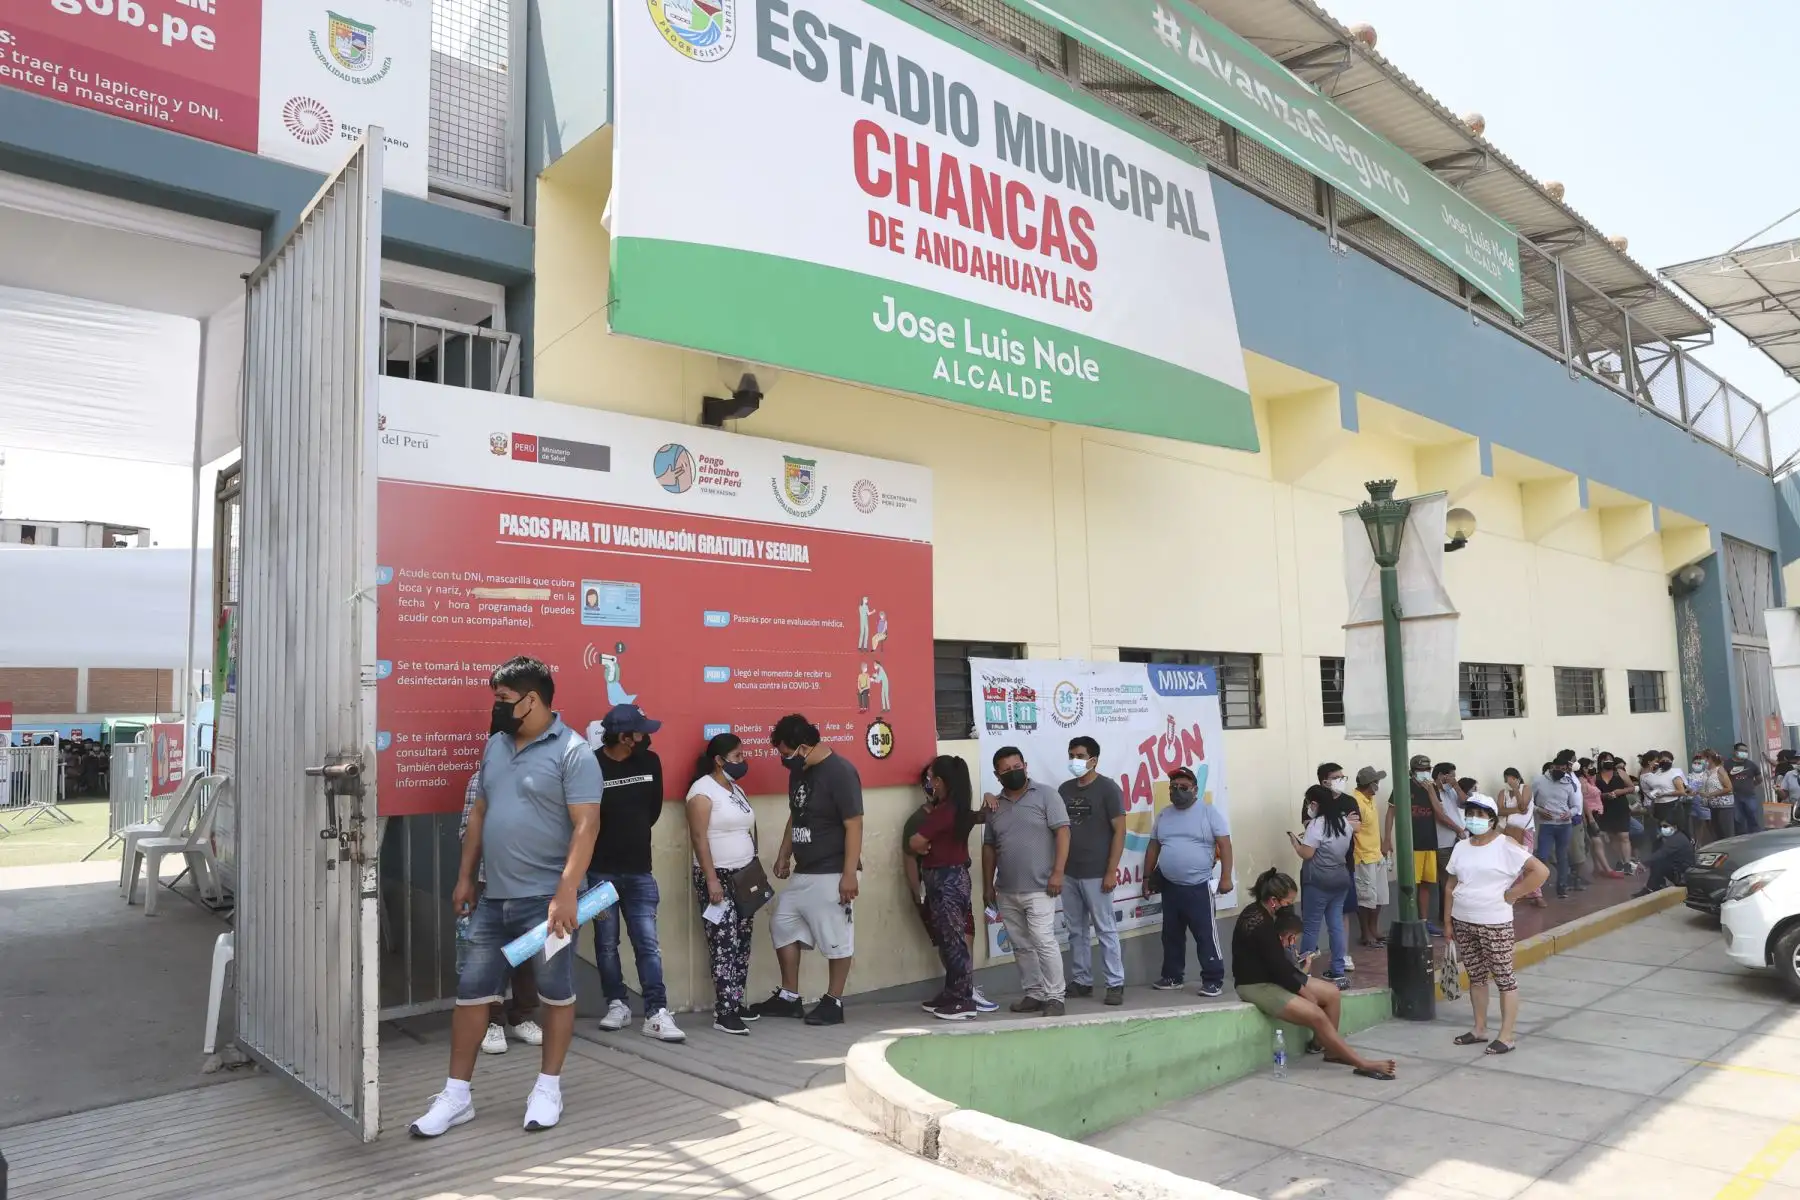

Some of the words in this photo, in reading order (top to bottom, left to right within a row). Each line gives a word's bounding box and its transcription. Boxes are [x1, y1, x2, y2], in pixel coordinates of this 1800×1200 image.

[659, 20, 725, 57] PROGRESISTA
[307, 29, 351, 82] MUNICIPALIDAD
[351, 76, 361, 85] DE
[12, 50, 63, 75] traer
[69, 66, 89, 83] tu
[95, 73, 168, 106] lapicero
[172, 98, 183, 112] y
[188, 101, 224, 122] DNI.
[52, 76, 69, 94] la
[75, 85, 175, 123] mascarilla.
[1151, 4, 1411, 206] #AvanzaSeguro
[757, 0, 980, 148] ESTADIO
[994, 99, 1211, 243] MUNICIPAL
[852, 118, 1098, 272] CHANCAS
[867, 209, 906, 256] DE
[914, 226, 1094, 313] ANDAHUAYLAS
[872, 295, 956, 349] Jose
[964, 318, 1026, 366] Luis
[1033, 336, 1101, 382] Nole
[932, 356, 1054, 404] ALCALDE
[381, 434, 400, 446] del
[403, 436, 430, 450] Perú
[514, 442, 536, 453] PERÚ
[541, 446, 572, 457] Ministerio
[698, 454, 725, 467] Pongo
[699, 464, 707, 473] el
[707, 465, 740, 478] hombro
[698, 475, 713, 485] por
[714, 476, 722, 486] el
[723, 477, 743, 489] Perú
[771, 477, 801, 518] MUNICIPALIDAD
[499, 513, 551, 539] PASOS
[552, 518, 591, 544] PARA
[592, 522, 612, 545] TU
[612, 524, 697, 553] VACUNACIÓN
[698, 533, 756, 559] GRATUITA
[755, 541, 765, 560] Y
[765, 541, 810, 564] SEGURA
[398, 568, 430, 578] Acude
[432, 571, 450, 580] con
[451, 571, 462, 580] tu
[464, 571, 484, 582] DNI,
[486, 575, 531, 585] mascarilla
[532, 578, 550, 587] que
[551, 577, 575, 588] cubra
[398, 581, 423, 593] boca
[426, 585, 433, 596] y
[435, 584, 462, 597] nariz,
[553, 593, 564, 601] en
[567, 591, 575, 602] la
[398, 597, 426, 608] fecha
[433, 600, 440, 611] y
[448, 599, 471, 610] hora
[478, 602, 533, 614] programada
[540, 604, 575, 615] (puedes
[398, 612, 429, 623] acudir
[431, 615, 449, 623] con
[451, 616, 464, 624] un
[466, 615, 534, 629] acompañante).
[733, 614, 759, 624] Pasarás
[760, 617, 772, 626] por
[773, 617, 786, 625] una
[786, 616, 820, 627] evaluación
[821, 617, 845, 628] médica.
[397, 660, 410, 671] Se
[412, 661, 422, 671] te
[424, 660, 459, 671] tomará
[461, 661, 470, 671] la
[397, 676, 463, 686] desinfectarán
[465, 676, 479, 686] las
[733, 668, 752, 679] Llegó
[753, 668, 760, 678] el
[761, 669, 793, 678] momento
[794, 669, 803, 678] de
[803, 669, 824, 678] recibir
[824, 670, 832, 678] tu
[1157, 669, 1208, 690] MINSA
[733, 682, 758, 690] vacuna
[758, 681, 781, 690] contra
[781, 681, 788, 690] la
[734, 723, 762, 733] Deberás
[825, 722, 841, 731] Área
[845, 723, 854, 731] de
[396, 732, 409, 743] Se
[411, 732, 422, 742] te
[425, 731, 472, 742] informará
[871, 733, 891, 746] 15-30
[396, 746, 447, 758] consultará
[453, 745, 480, 756] sobre
[754, 748, 764, 757] 15
[396, 762, 436, 774] También
[437, 761, 474, 772] deberás
[395, 778, 448, 789] informado.
